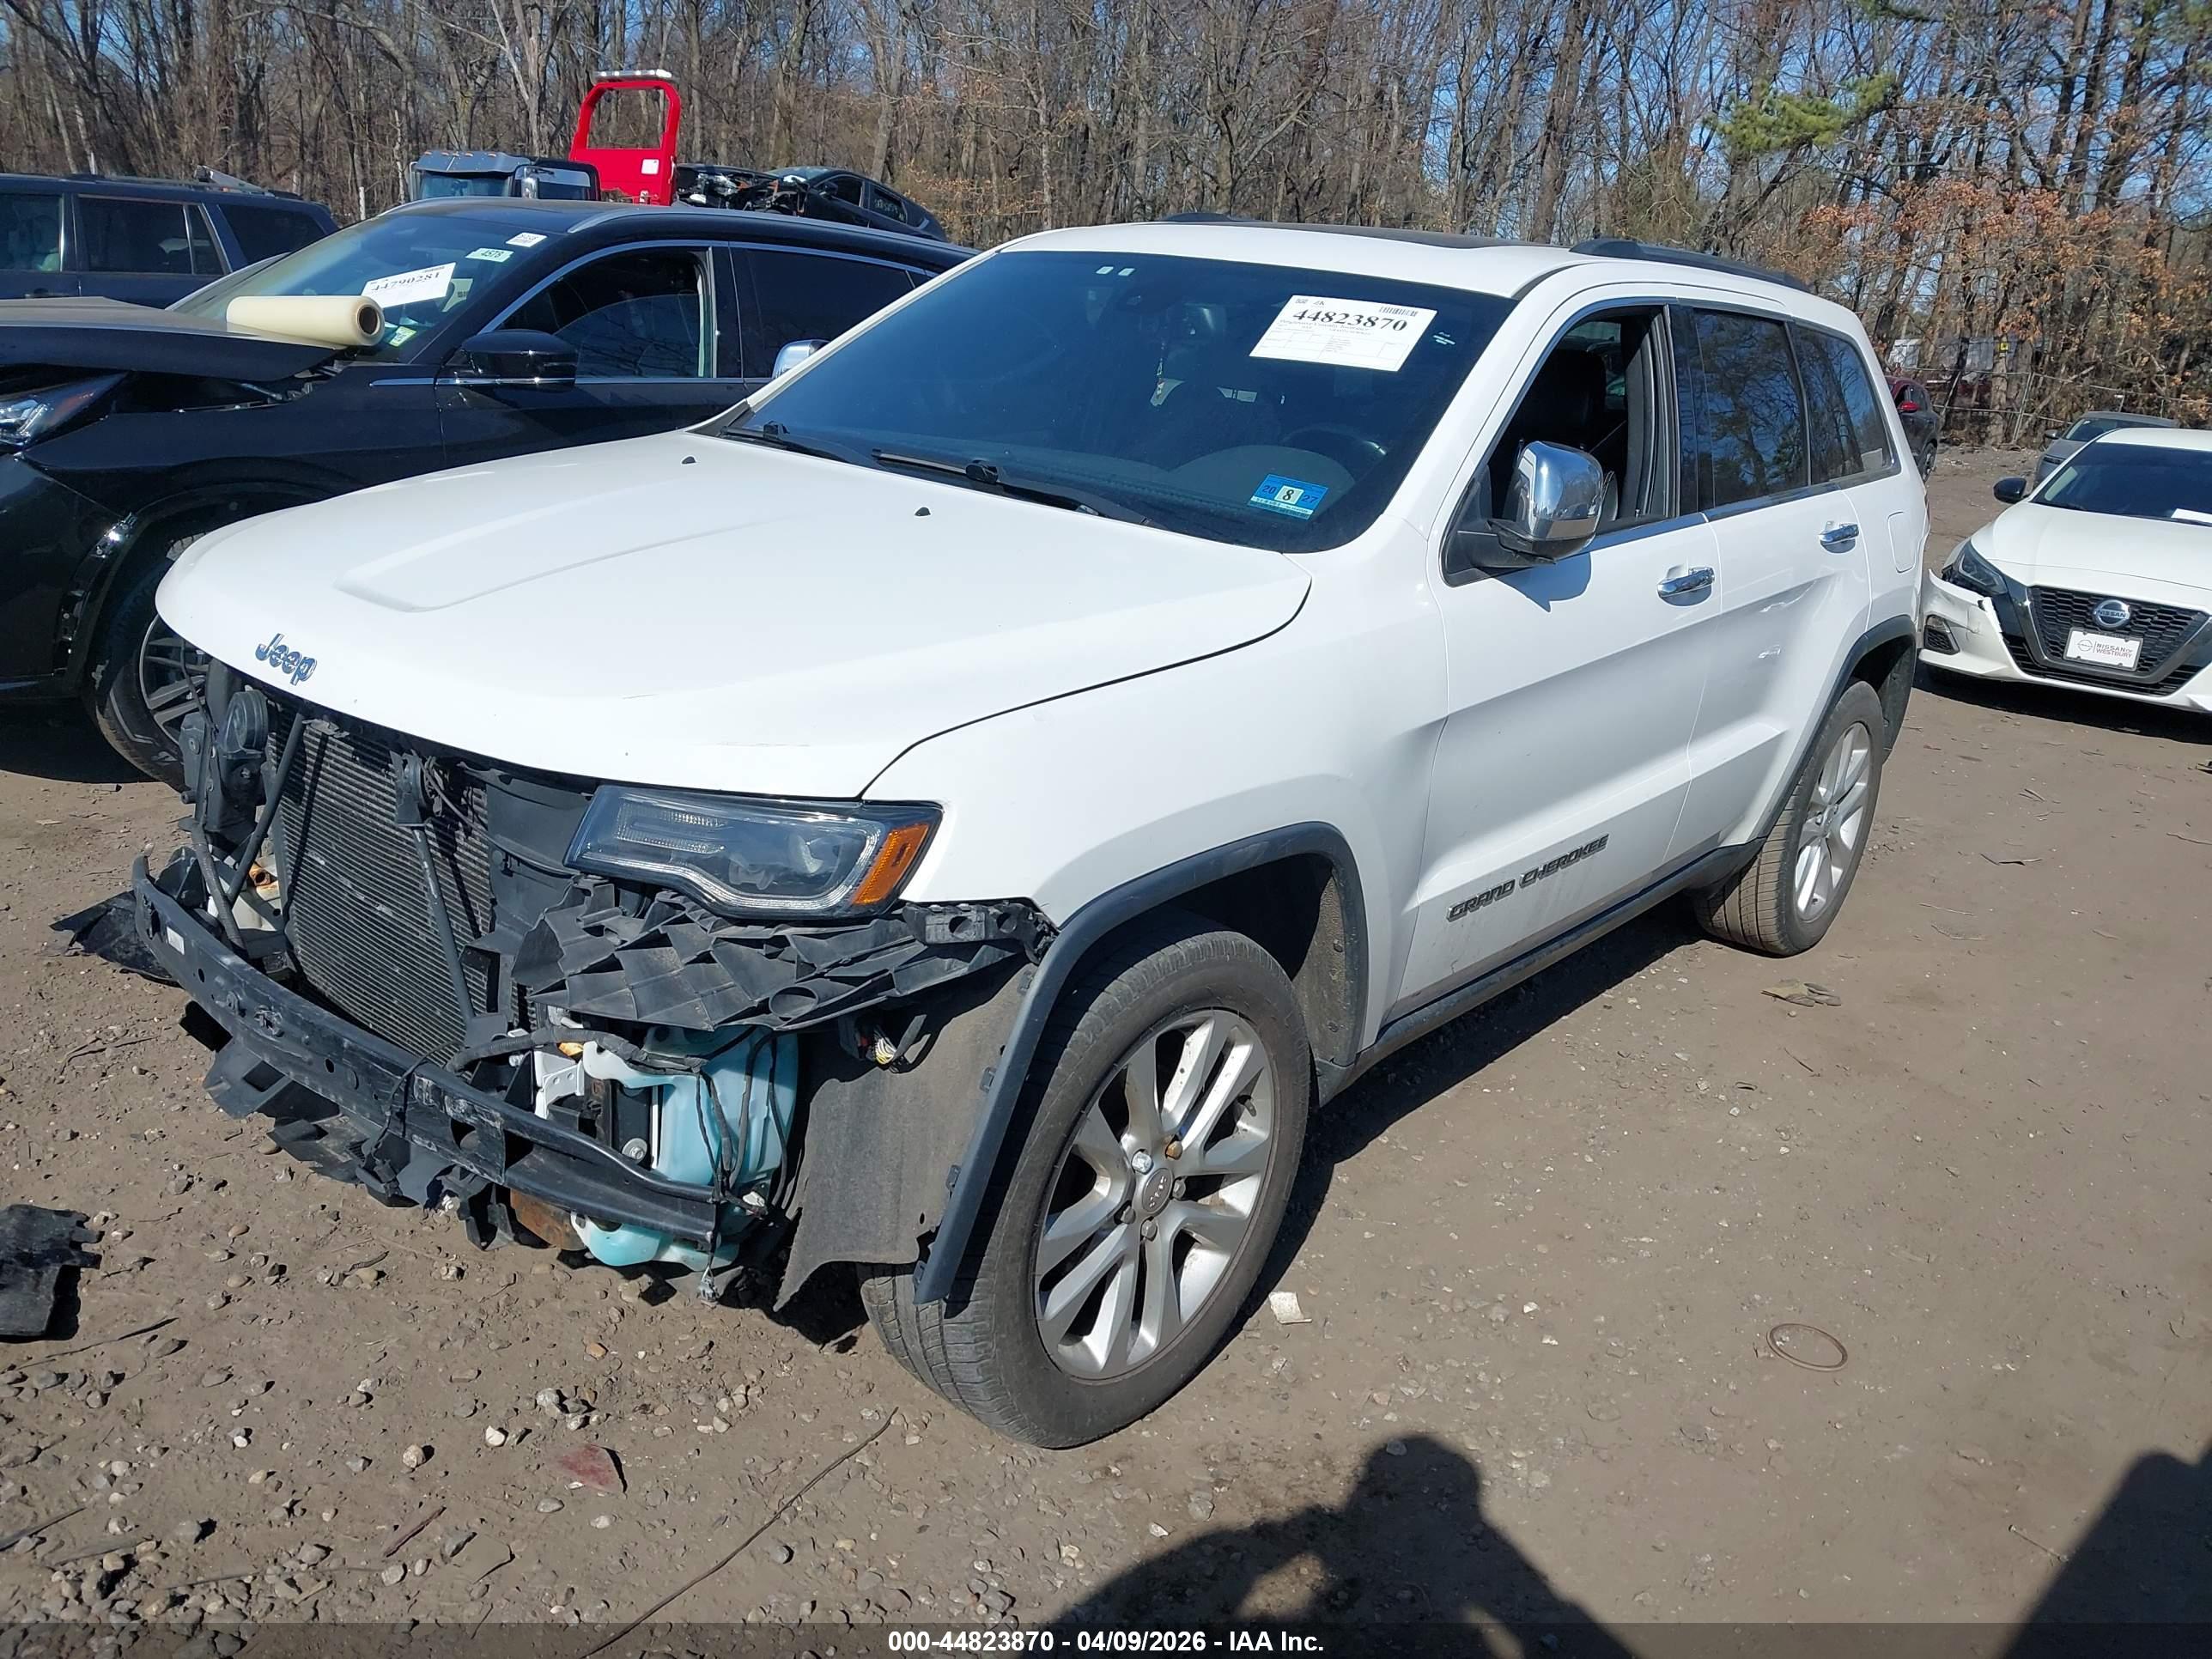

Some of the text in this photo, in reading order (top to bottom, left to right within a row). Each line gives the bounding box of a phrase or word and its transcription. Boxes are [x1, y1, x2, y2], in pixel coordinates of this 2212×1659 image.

[1292, 308, 1408, 331] 44823870
[1282, 489, 1294, 501] 8
[1301, 495, 1319, 504] 27
[2095, 647, 2133, 659] WESTBURY
[2096, 643, 2125, 653] NISSAN
[255, 632, 318, 686] Jeep
[1446, 833, 1610, 922] GRAND CHEROKEE
